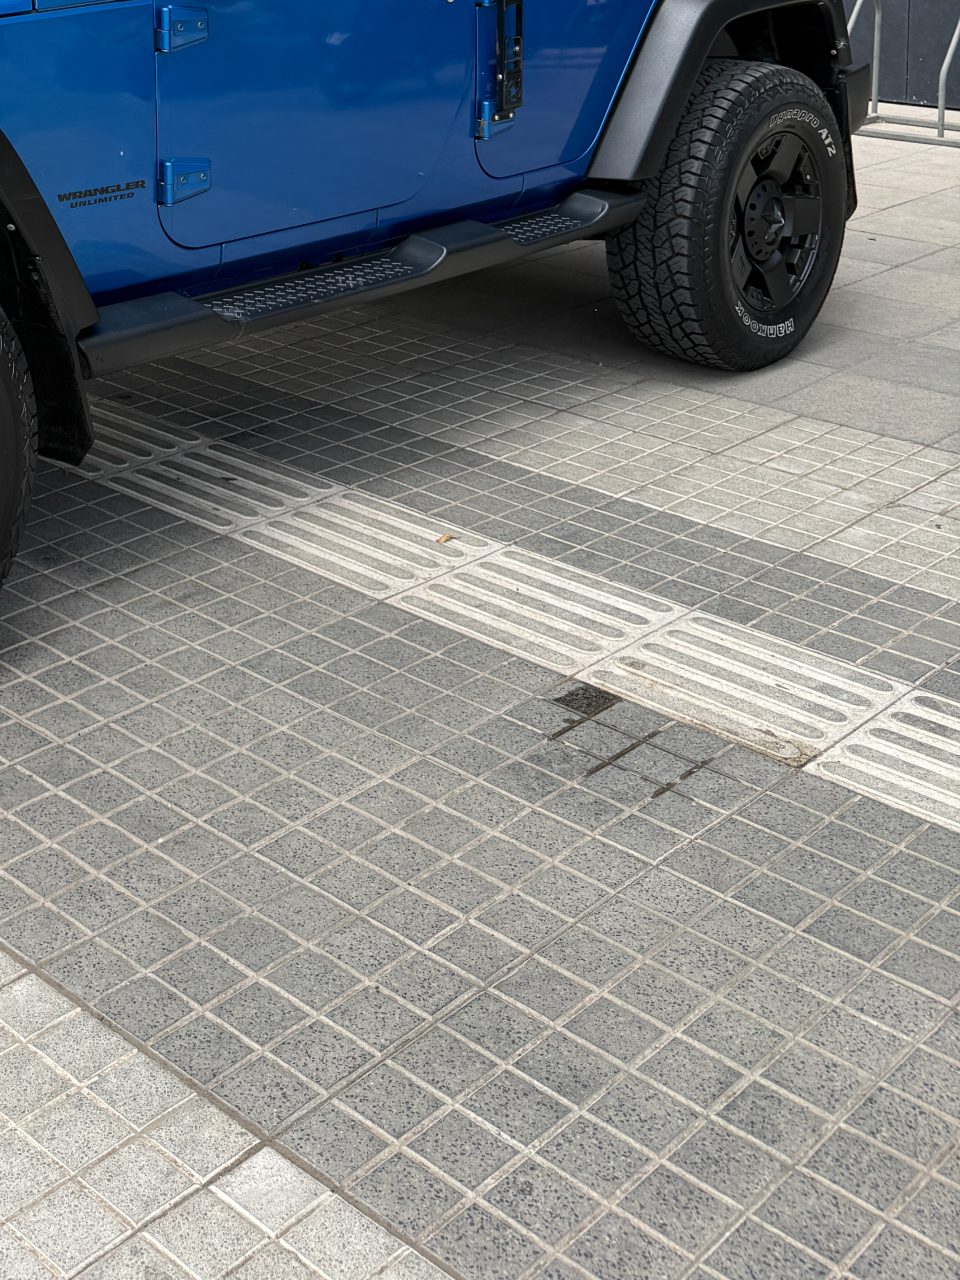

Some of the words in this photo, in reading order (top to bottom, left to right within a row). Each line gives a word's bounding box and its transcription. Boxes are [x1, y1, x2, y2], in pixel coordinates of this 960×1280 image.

[769, 109, 820, 128] Dynapro
[818, 128, 836, 157] AT2
[57, 179, 147, 202] WRANGLER
[70, 192, 135, 209] UNLIMITED
